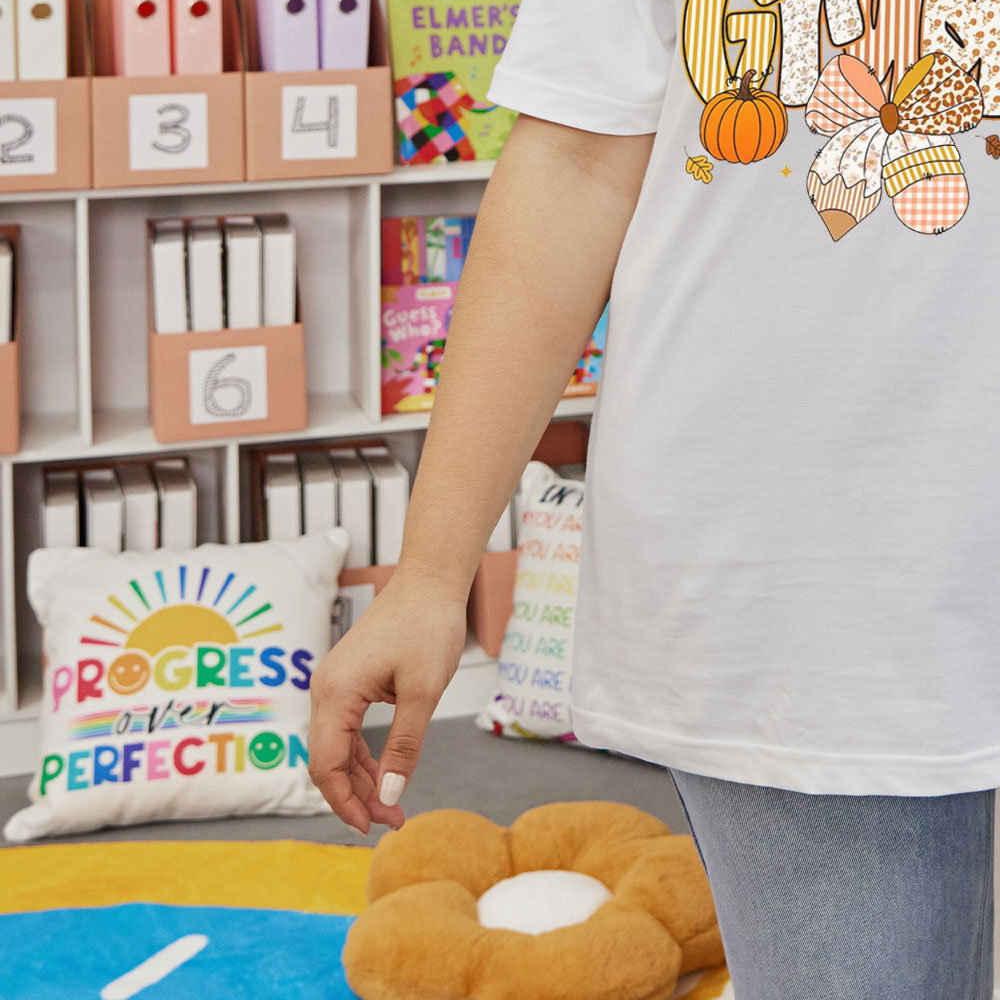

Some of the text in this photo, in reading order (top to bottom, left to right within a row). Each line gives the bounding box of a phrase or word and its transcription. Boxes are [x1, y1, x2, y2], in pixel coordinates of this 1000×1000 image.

[430, 34, 508, 59] BAND
[151, 101, 193, 154] 3
[290, 94, 339, 148] 4
[0, 113, 36, 165] 2
[382, 305, 438, 328] Guess
[388, 318, 443, 344] Who?
[203, 352, 253, 418] 6
[539, 603, 573, 628] ARE
[534, 636, 568, 660] ARE
[52, 646, 314, 713] PROGRESS
[532, 666, 565, 692] ARE
[115, 698, 259, 735] over
[530, 698, 563, 722] ARE
